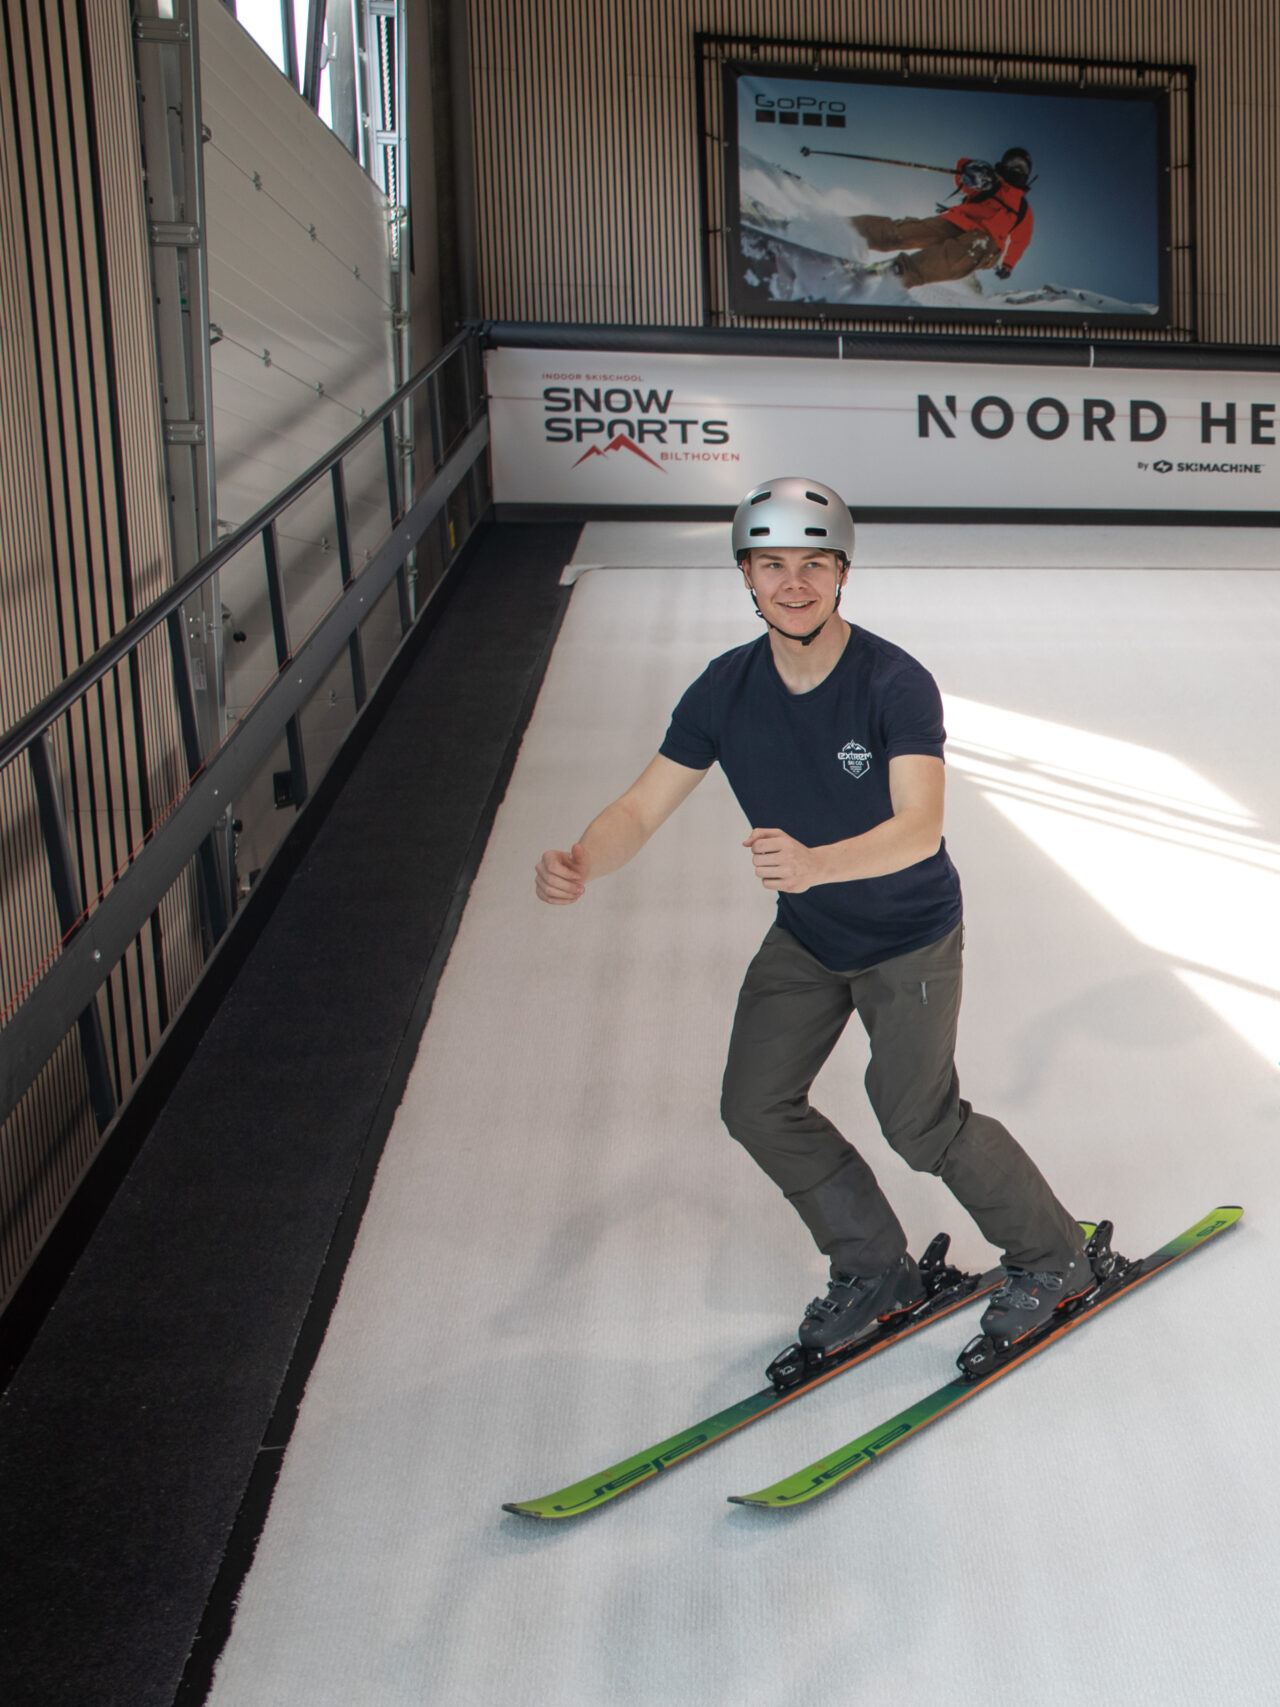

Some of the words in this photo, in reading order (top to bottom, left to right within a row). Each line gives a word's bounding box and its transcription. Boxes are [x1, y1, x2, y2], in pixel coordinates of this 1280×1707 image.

[755, 93, 846, 113] GoPro
[542, 373, 582, 381] INDOOR
[585, 374, 644, 383] SKISCHOOL
[543, 386, 674, 414] SNOW
[917, 394, 1167, 443] NOORD
[544, 417, 730, 445] SPORTS
[660, 452, 740, 462] BILTHOVEN
[1177, 462, 1262, 473] SKIMACHINE
